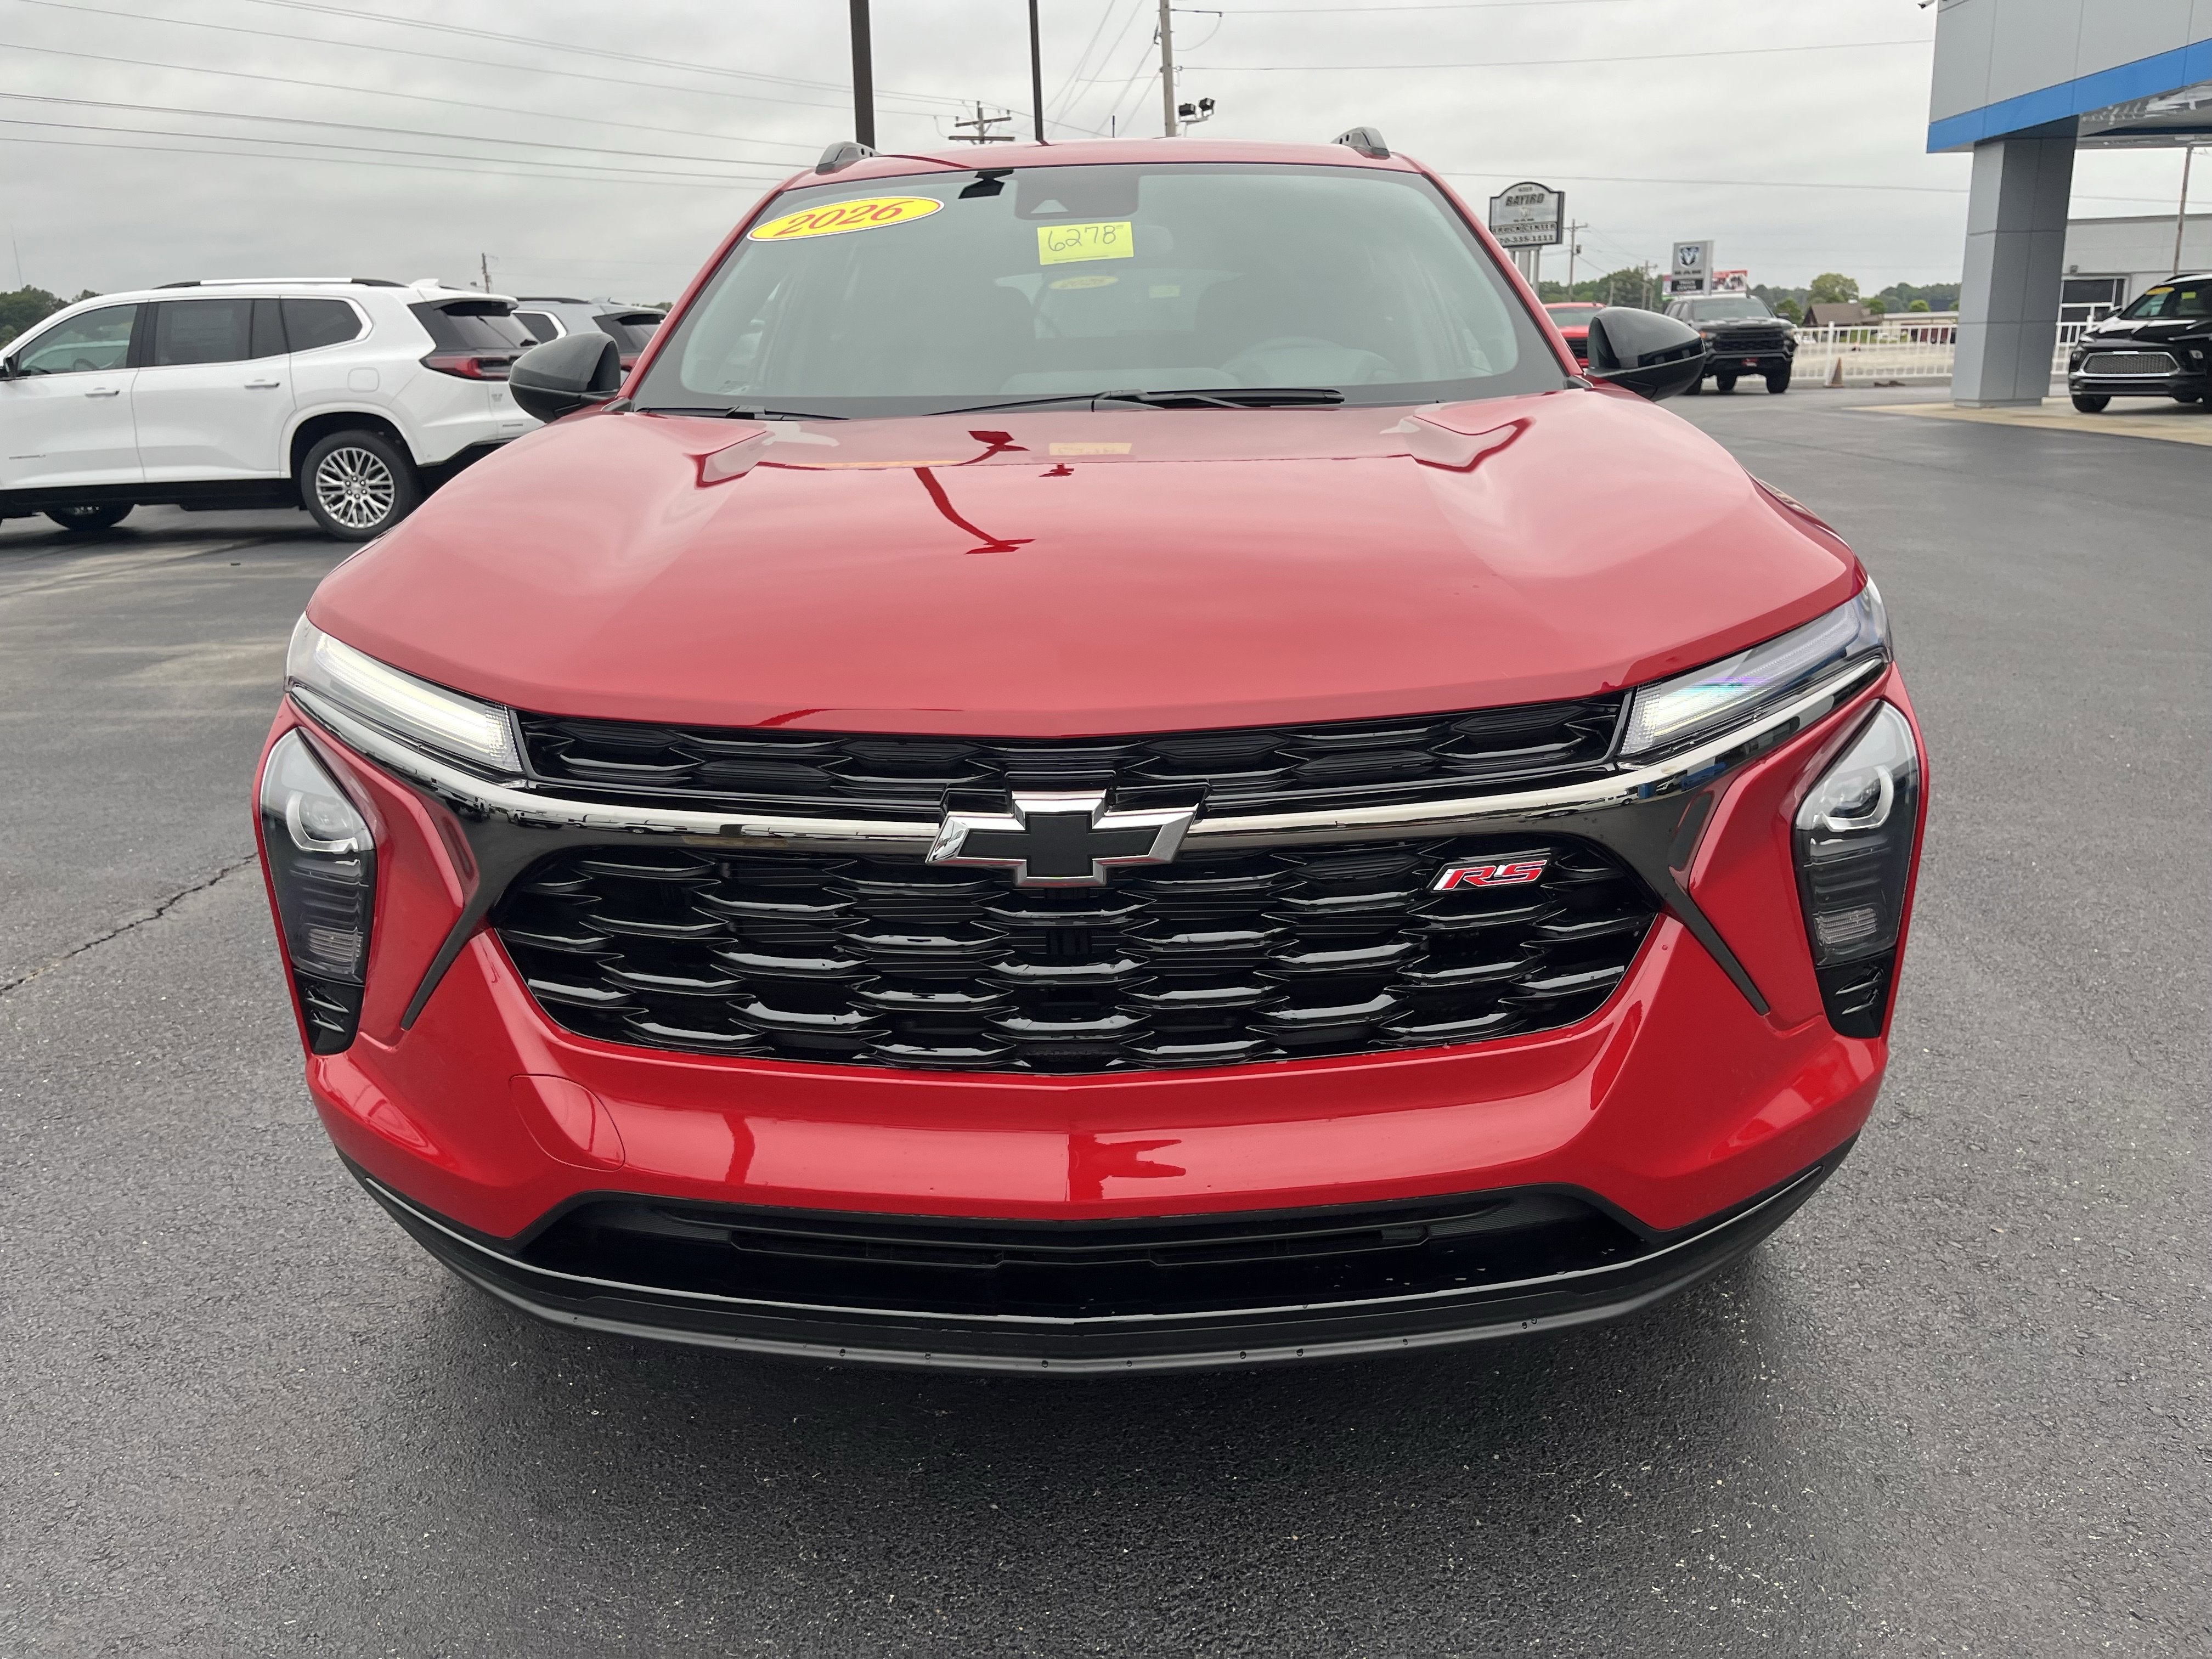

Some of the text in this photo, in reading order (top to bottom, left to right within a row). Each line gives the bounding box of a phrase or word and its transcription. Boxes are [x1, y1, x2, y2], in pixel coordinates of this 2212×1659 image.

[1505, 193, 1544, 206] BAYIRD
[773, 201, 914, 236] 2026
[1048, 225, 1116, 251] 6278
[1433, 860, 1548, 890] RS
